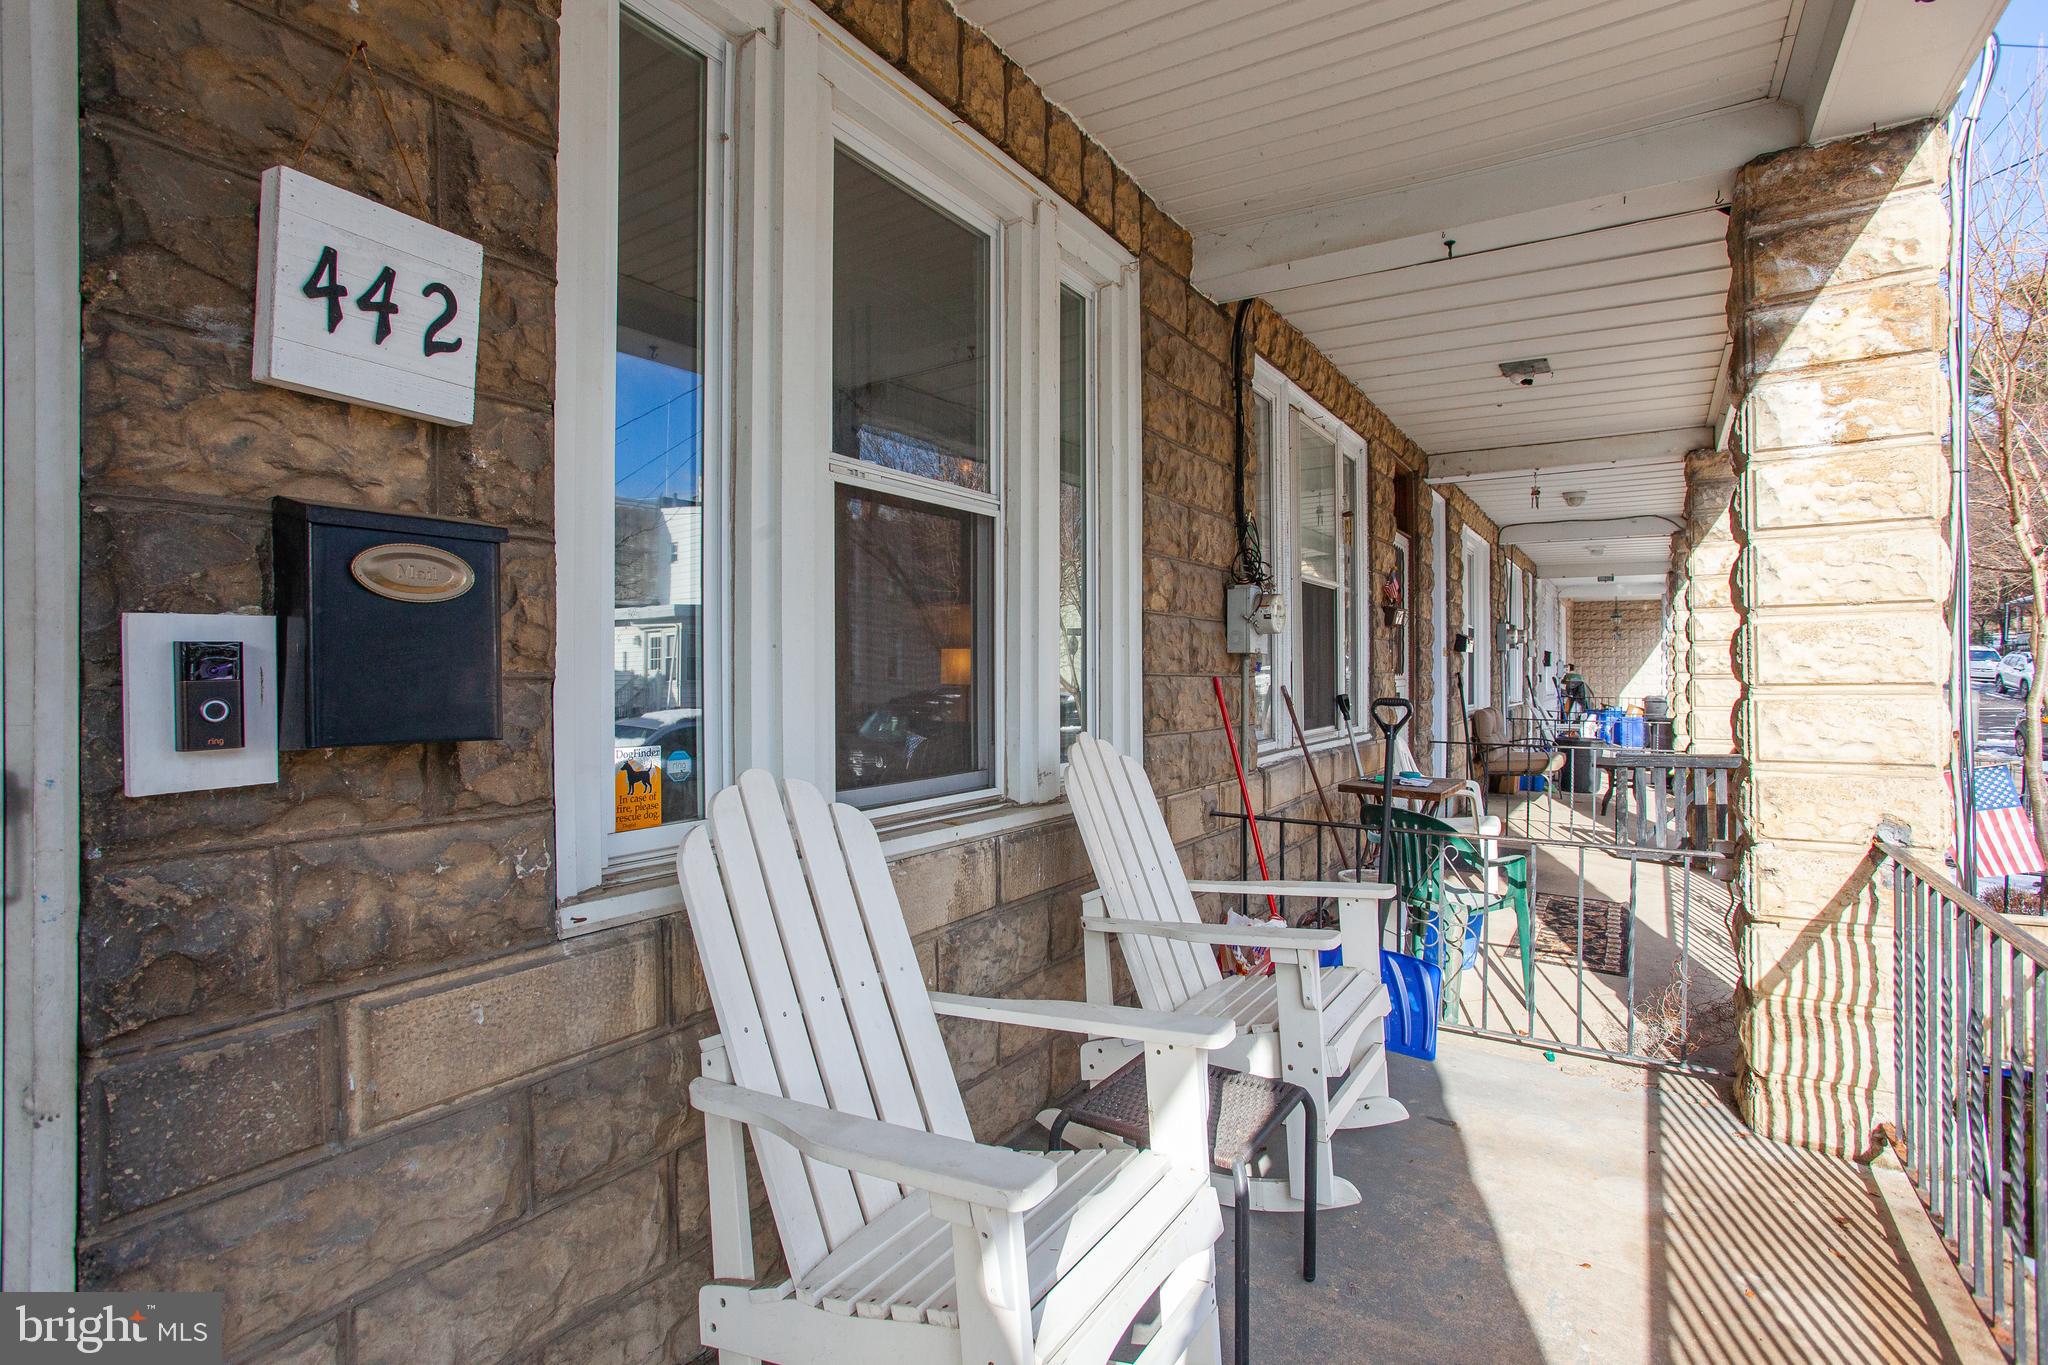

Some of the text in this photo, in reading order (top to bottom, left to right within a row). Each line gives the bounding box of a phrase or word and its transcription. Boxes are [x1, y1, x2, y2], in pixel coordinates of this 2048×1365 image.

[303, 245, 463, 357] 442
[208, 738, 224, 746] ring
[616, 748, 660, 760] DogFinder
[672, 762, 687, 771] ring
[619, 792, 656, 803] In case of
[616, 802, 659, 814] fire, please
[616, 811, 660, 822] rescue dog.
